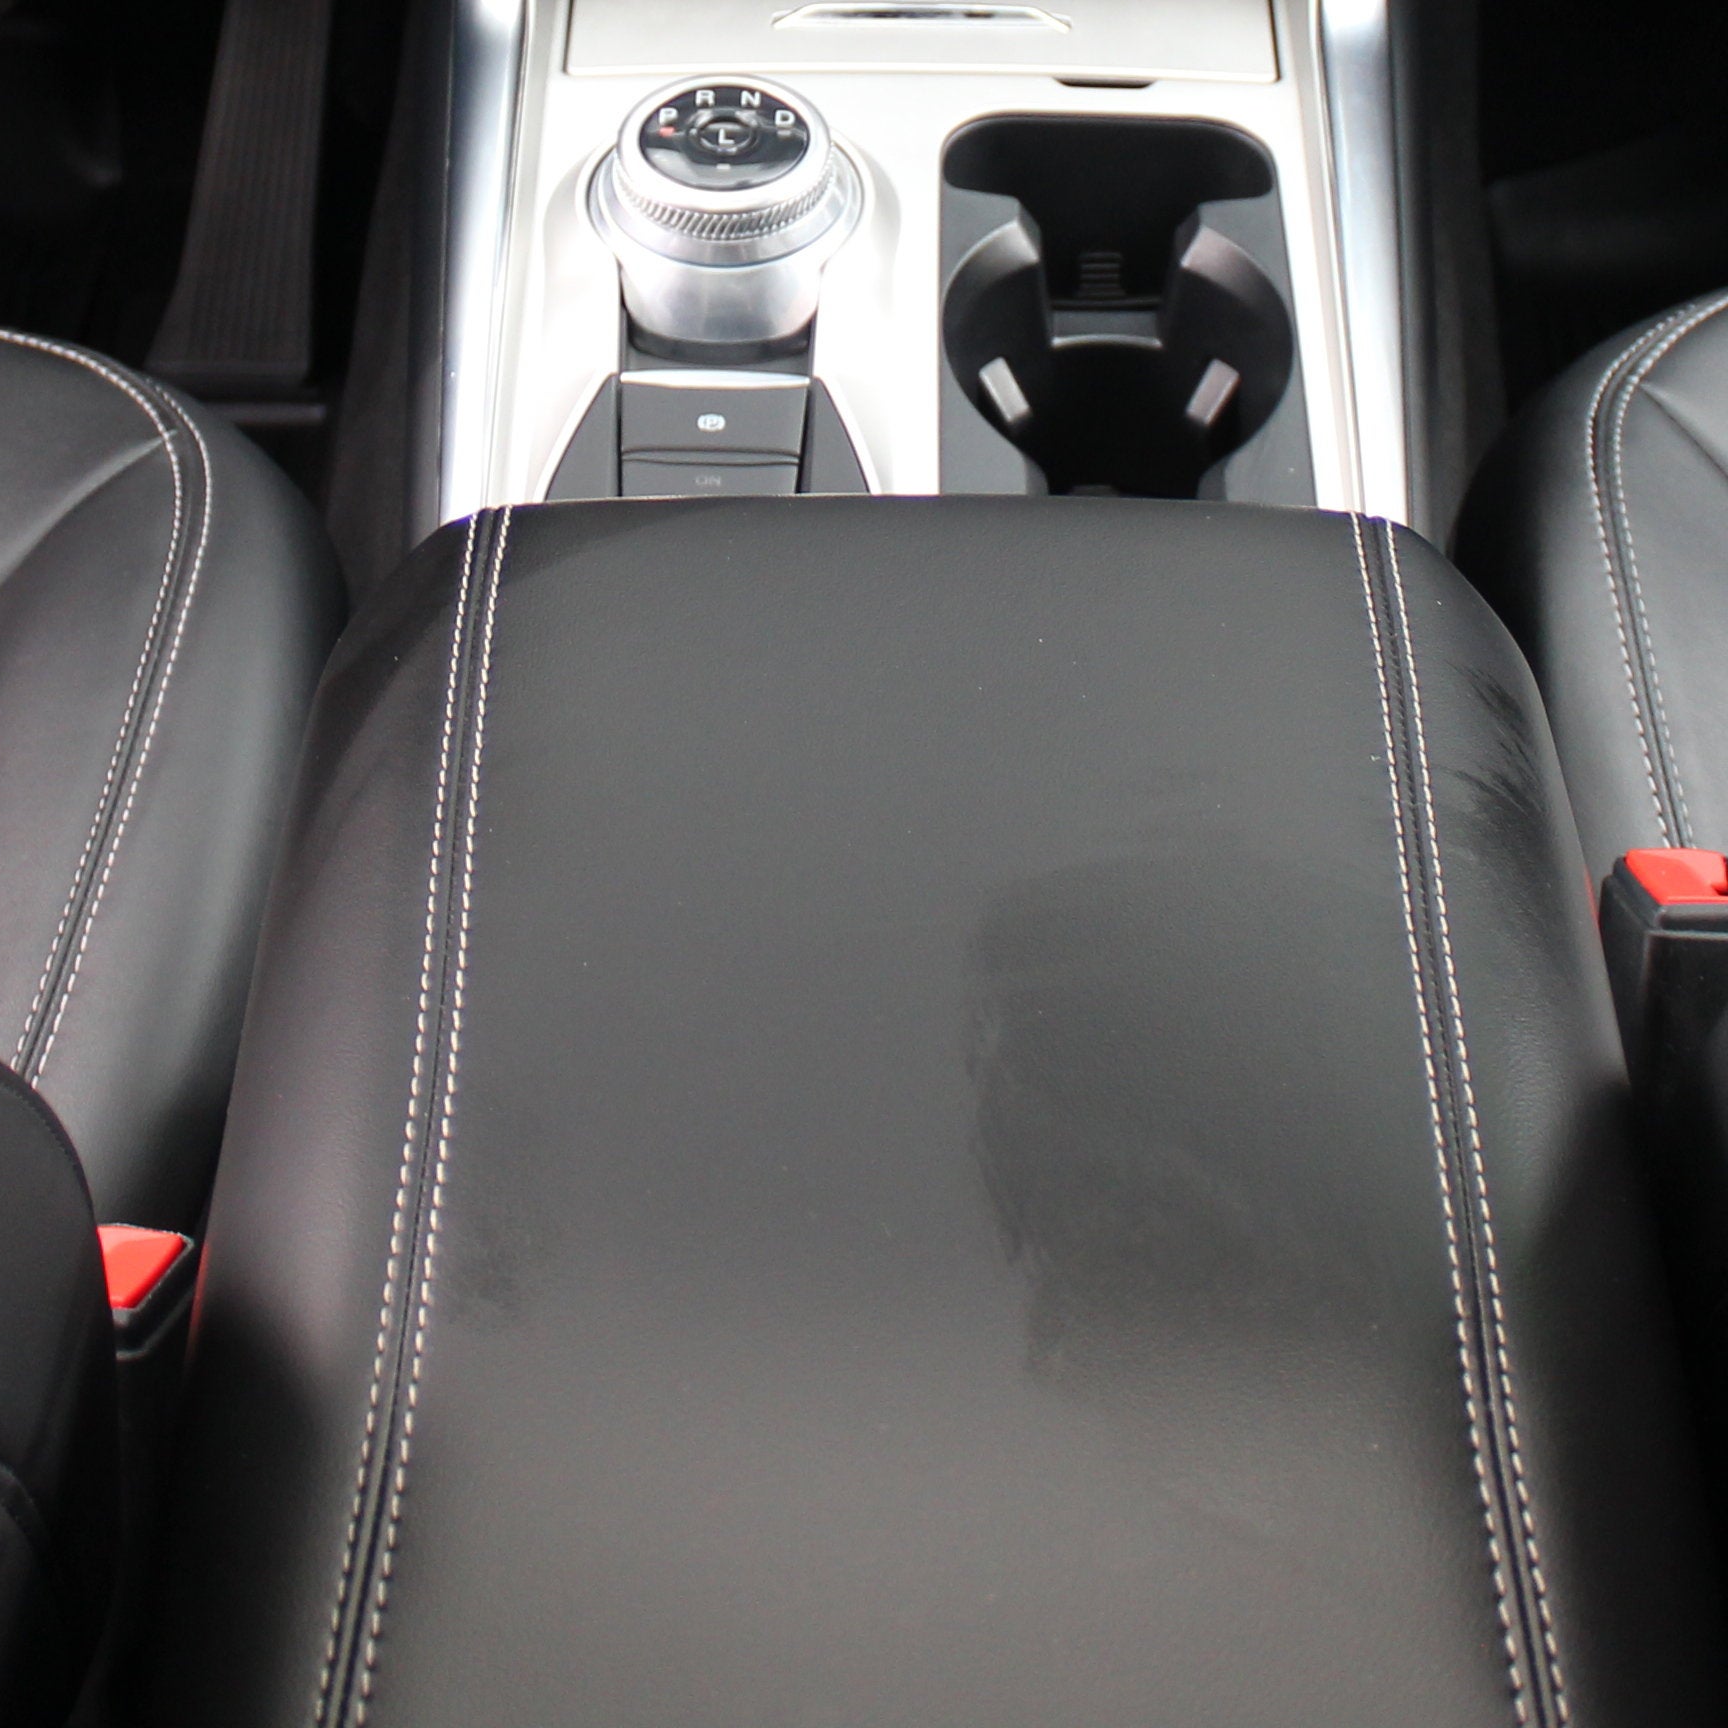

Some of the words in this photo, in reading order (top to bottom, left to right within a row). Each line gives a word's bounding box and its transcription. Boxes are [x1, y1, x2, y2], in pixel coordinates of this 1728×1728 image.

[694, 89, 716, 108] R
[740, 90, 762, 109] N
[658, 107, 679, 127] P
[774, 109, 796, 127] D
[717, 128, 735, 146] L
